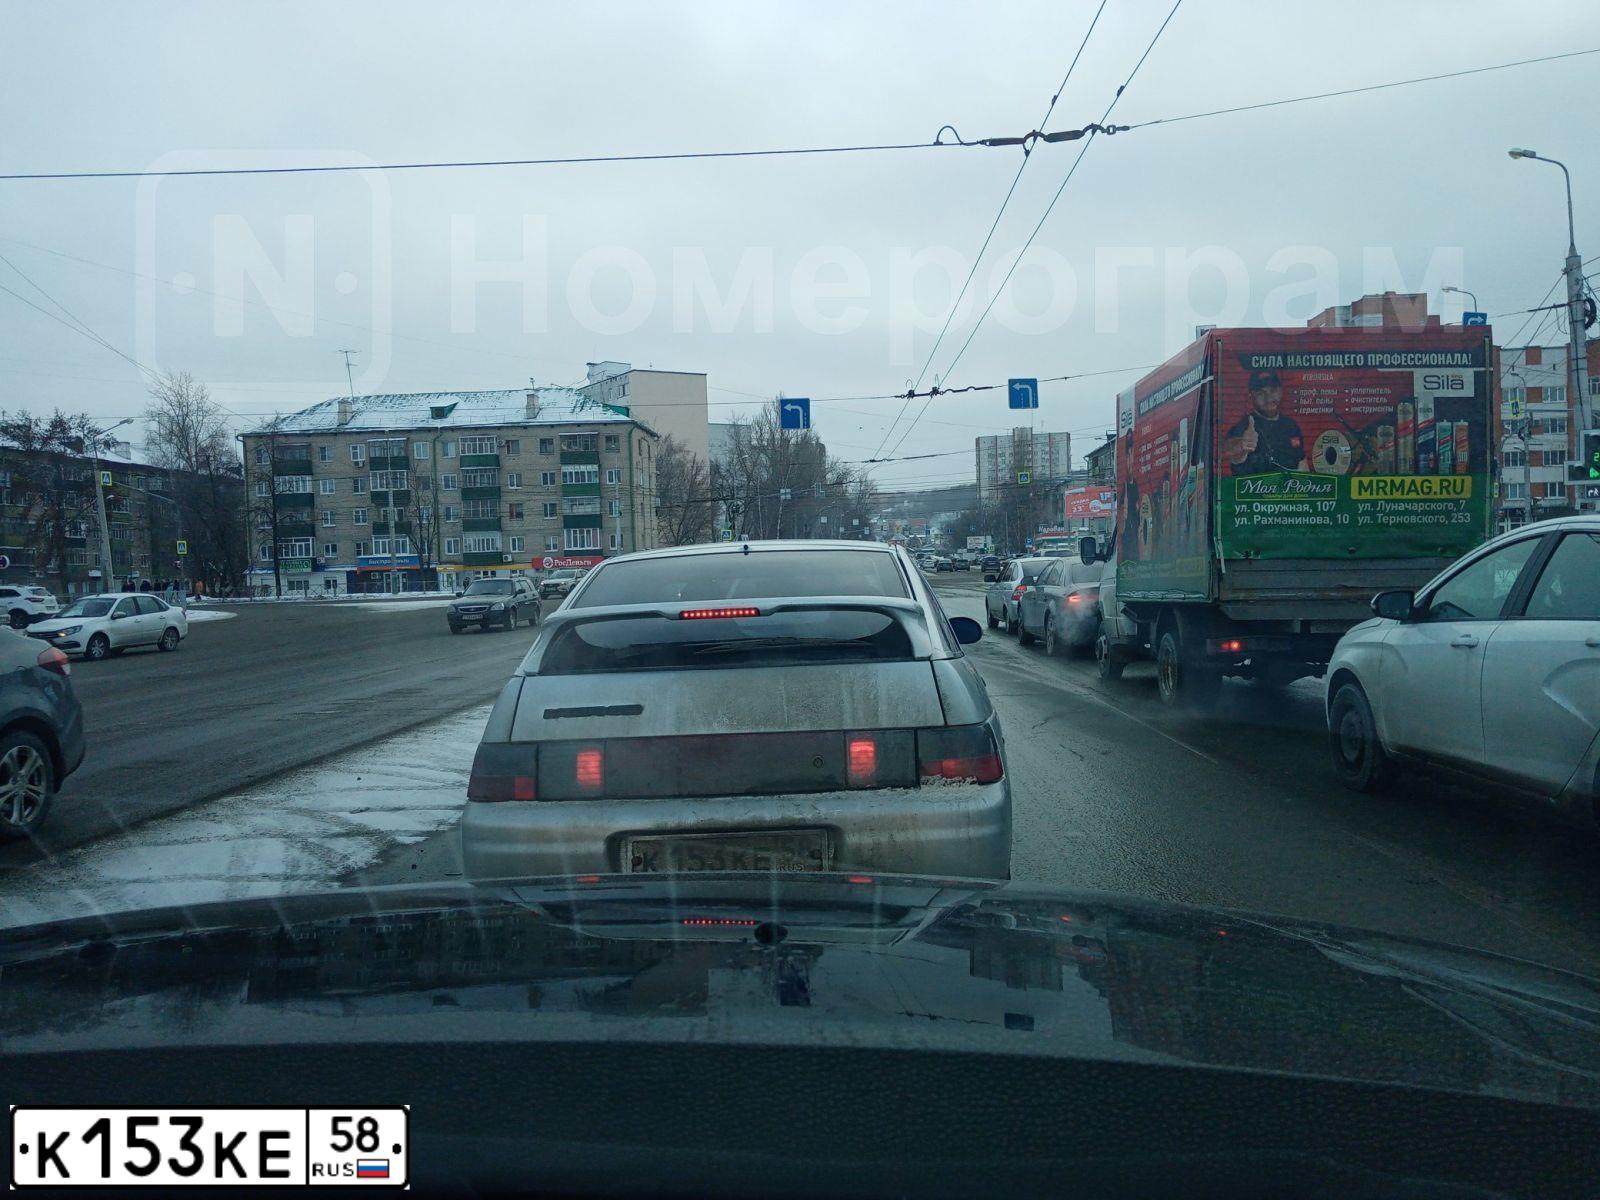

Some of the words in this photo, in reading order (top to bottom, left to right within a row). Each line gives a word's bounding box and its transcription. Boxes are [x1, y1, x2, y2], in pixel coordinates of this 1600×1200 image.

[1251, 355, 1284, 368] СИЛА
[1286, 353, 1365, 368] НАСТОЯЩЕГО
[1367, 352, 1472, 367] ПРОФЕССИОНАЛА!
[1423, 374, 1465, 391] Sila
[1240, 479, 1277, 494] Моя
[1282, 478, 1332, 494] Родня
[1357, 478, 1465, 497] MRMAG.RU
[1234, 504, 1251, 514] ул.
[1252, 502, 1313, 514] Окружная,
[1316, 501, 1336, 512] 107
[1357, 502, 1374, 513] ул.
[1376, 501, 1457, 513] Луначарского,
[1459, 500, 1466, 511] 7
[1234, 516, 1251, 527] ул.
[1253, 514, 1333, 526] Рахманинова,
[1336, 513, 1350, 525] 10
[1357, 515, 1374, 526] ул.
[1376, 513, 1449, 525] Терновского,
[1450, 512, 1471, 523] 253
[553, 558, 592, 567] РосДеньги
